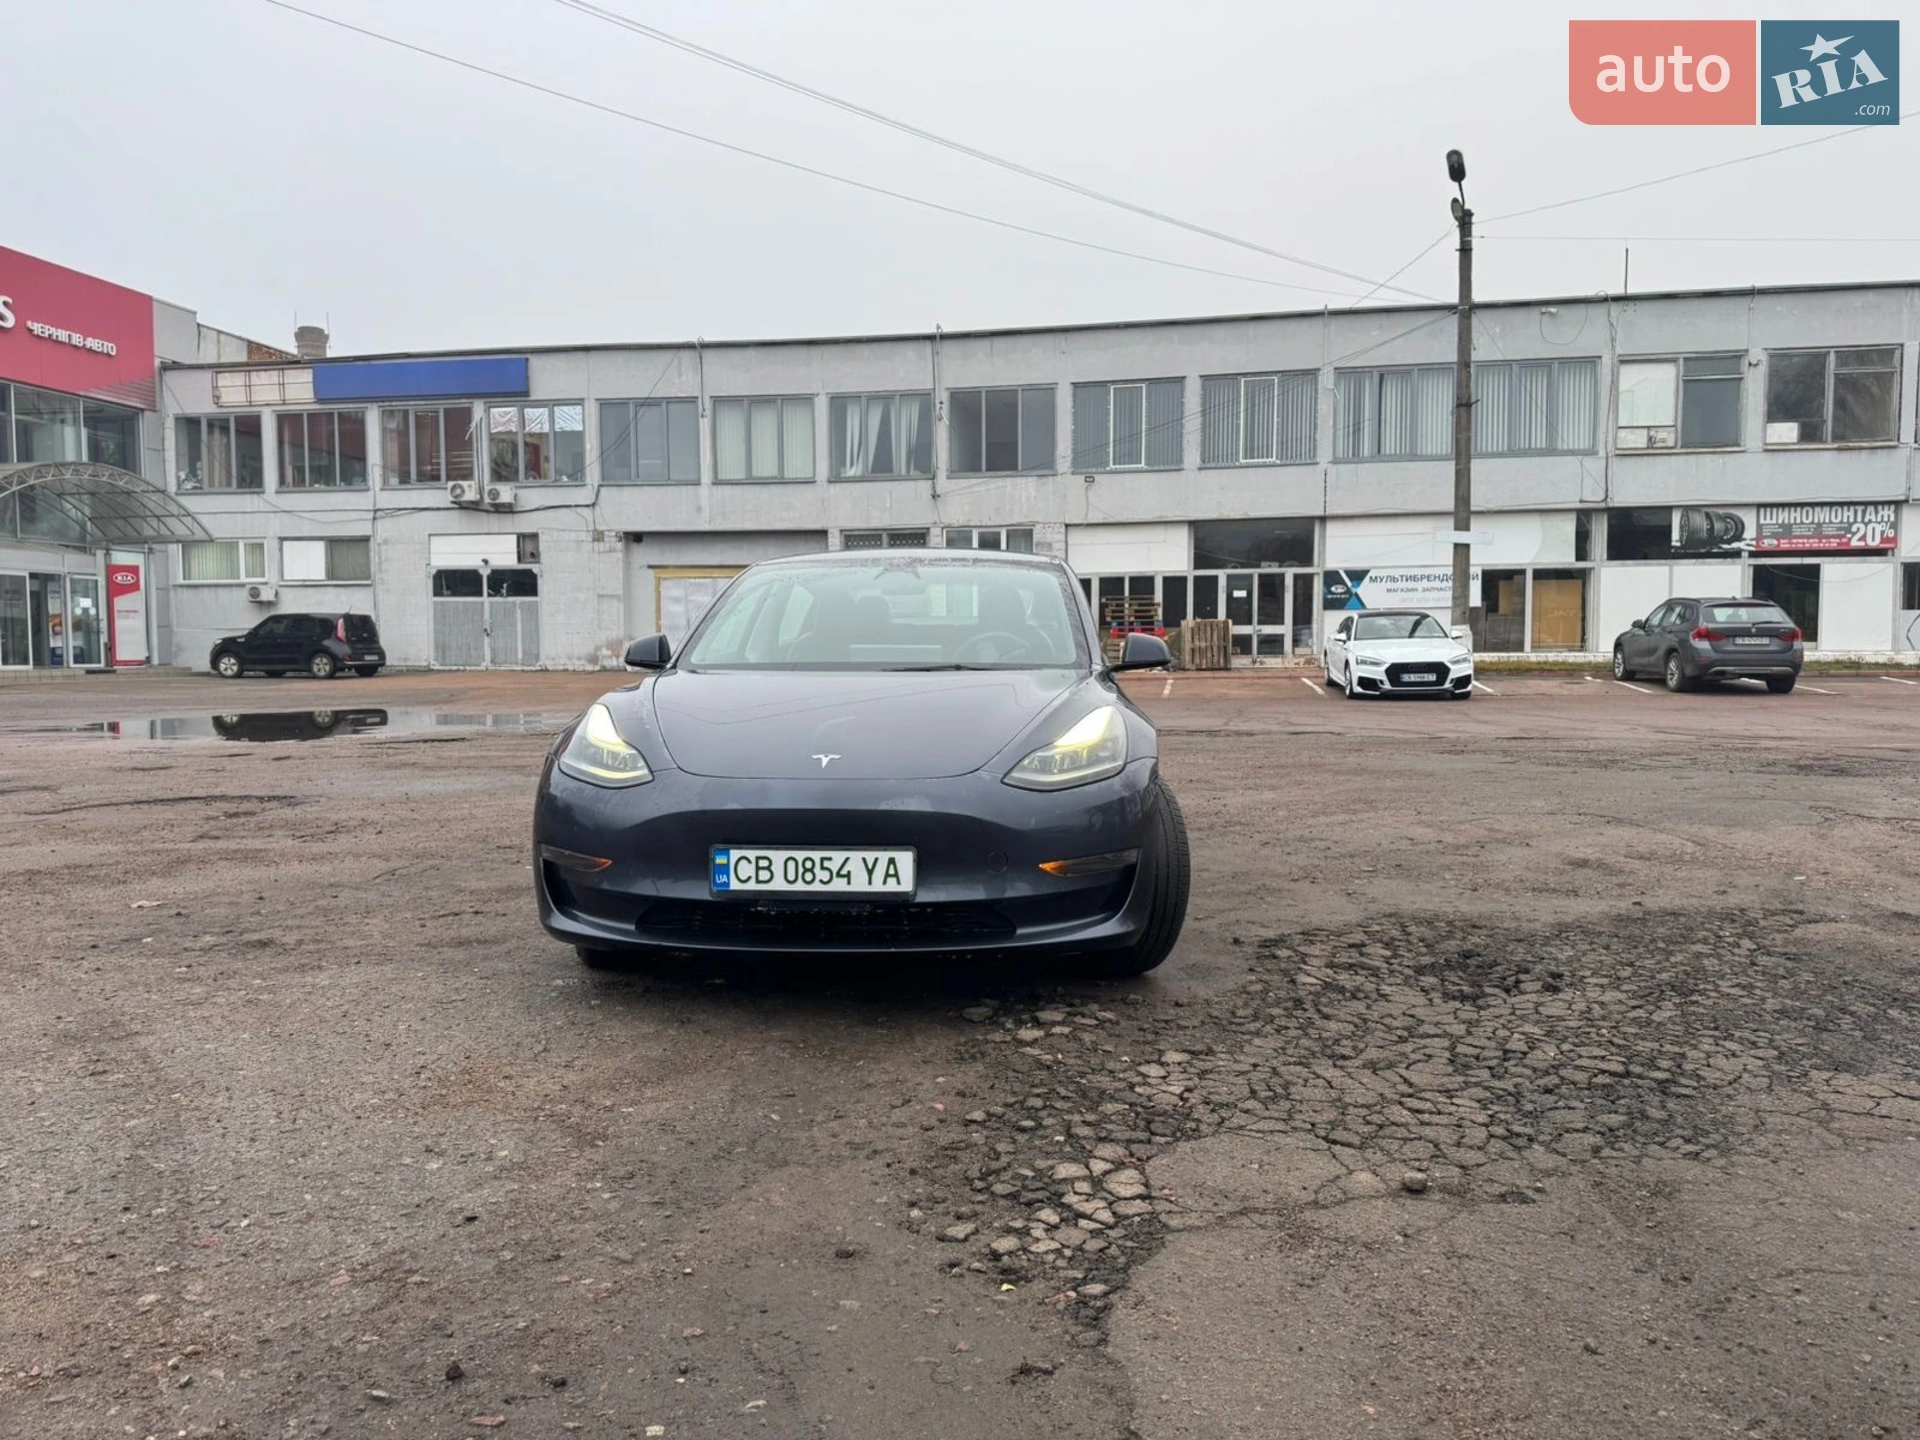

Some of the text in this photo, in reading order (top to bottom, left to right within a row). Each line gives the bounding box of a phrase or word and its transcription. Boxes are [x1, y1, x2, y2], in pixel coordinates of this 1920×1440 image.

[26, 320, 116, 356] ЧЕРНІГІВ-АВТО
[1759, 504, 1896, 524] ШИНОМОНТАЖ
[1846, 522, 1895, 547] -20%
[116, 574, 135, 583] KIA
[1368, 571, 1480, 583] МУЛЬТИБРЕНДОЙ
[715, 874, 728, 884] UA
[734, 855, 901, 886] CB 0854 YA
